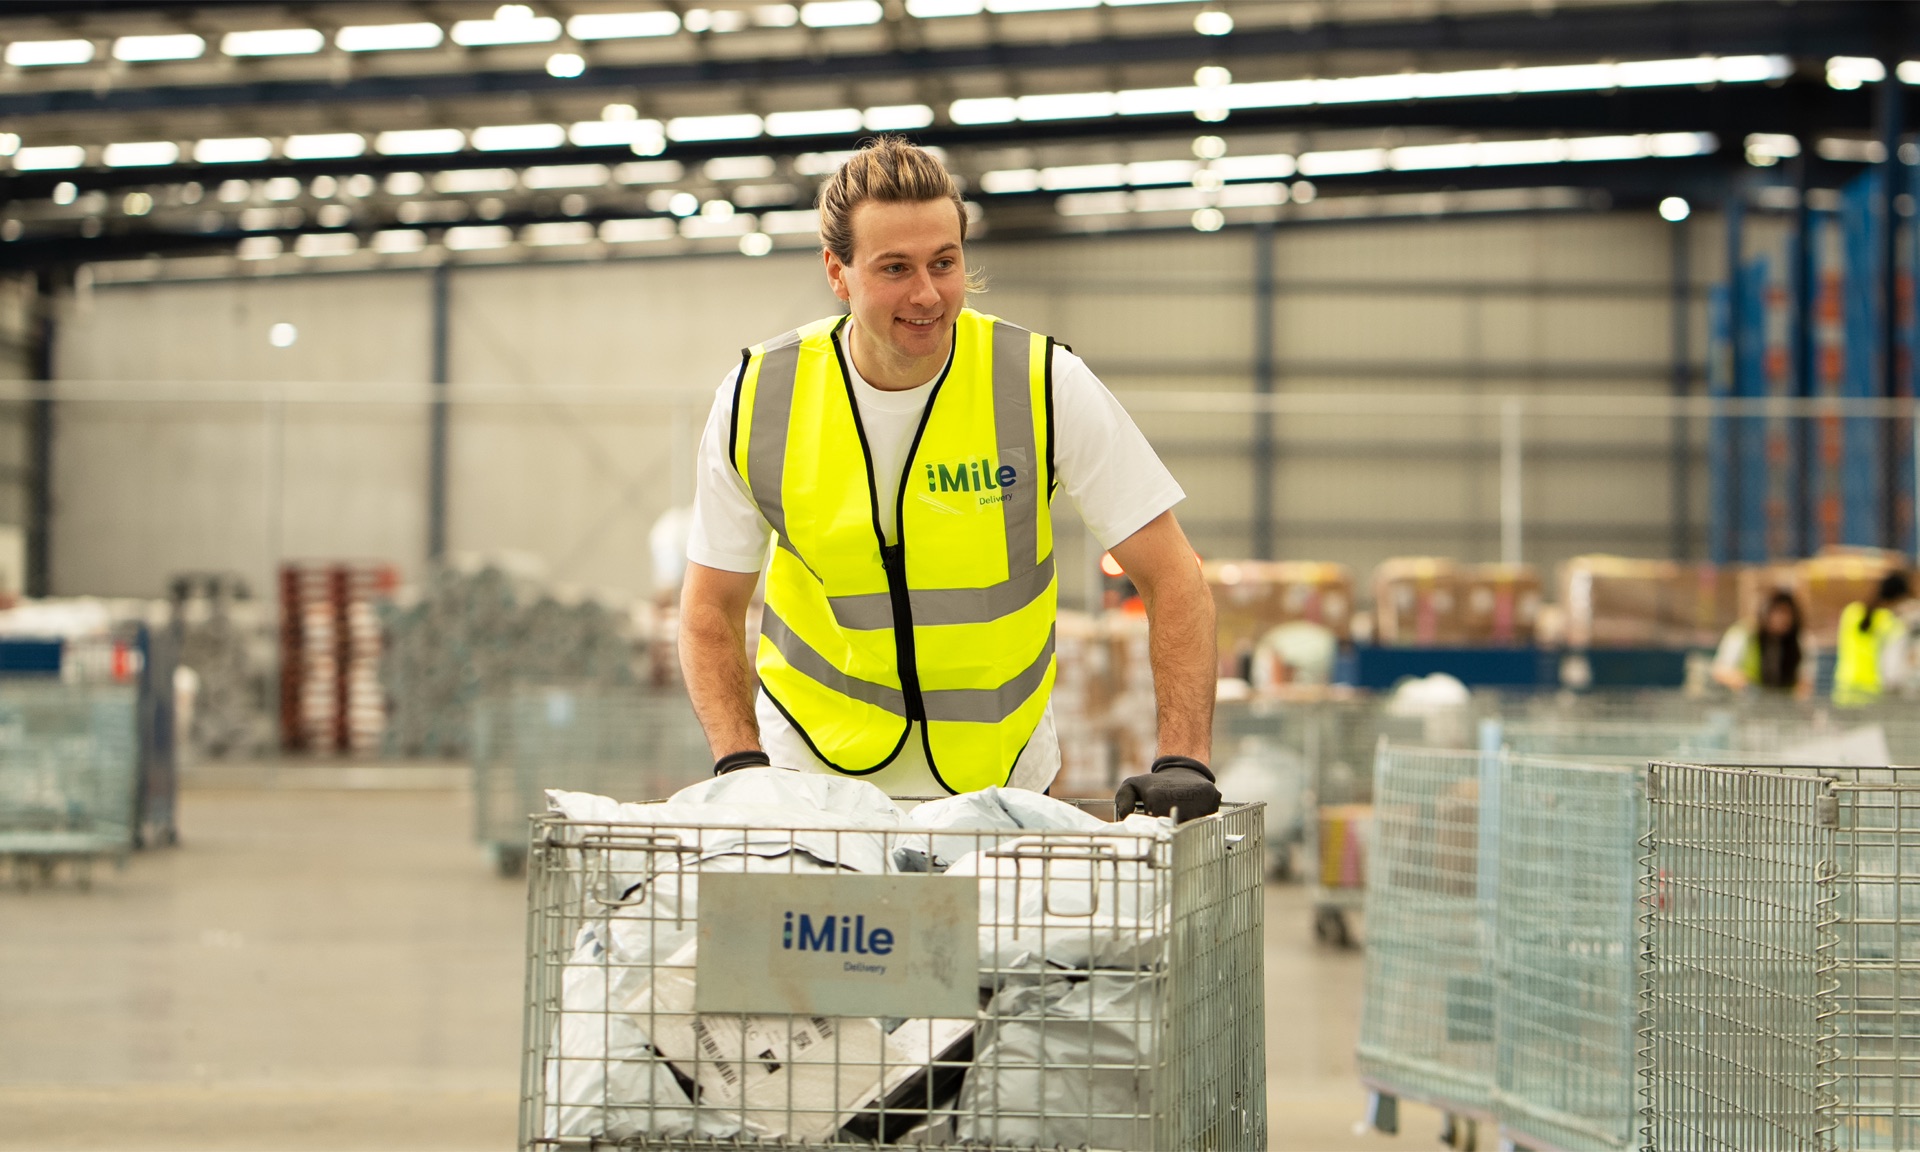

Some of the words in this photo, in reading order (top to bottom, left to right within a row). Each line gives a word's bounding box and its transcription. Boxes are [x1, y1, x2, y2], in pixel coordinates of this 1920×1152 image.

[925, 459, 1017, 493] iMile
[979, 493, 1013, 505] Delivery
[783, 911, 895, 955] iMile
[843, 961, 887, 976] Delivery
